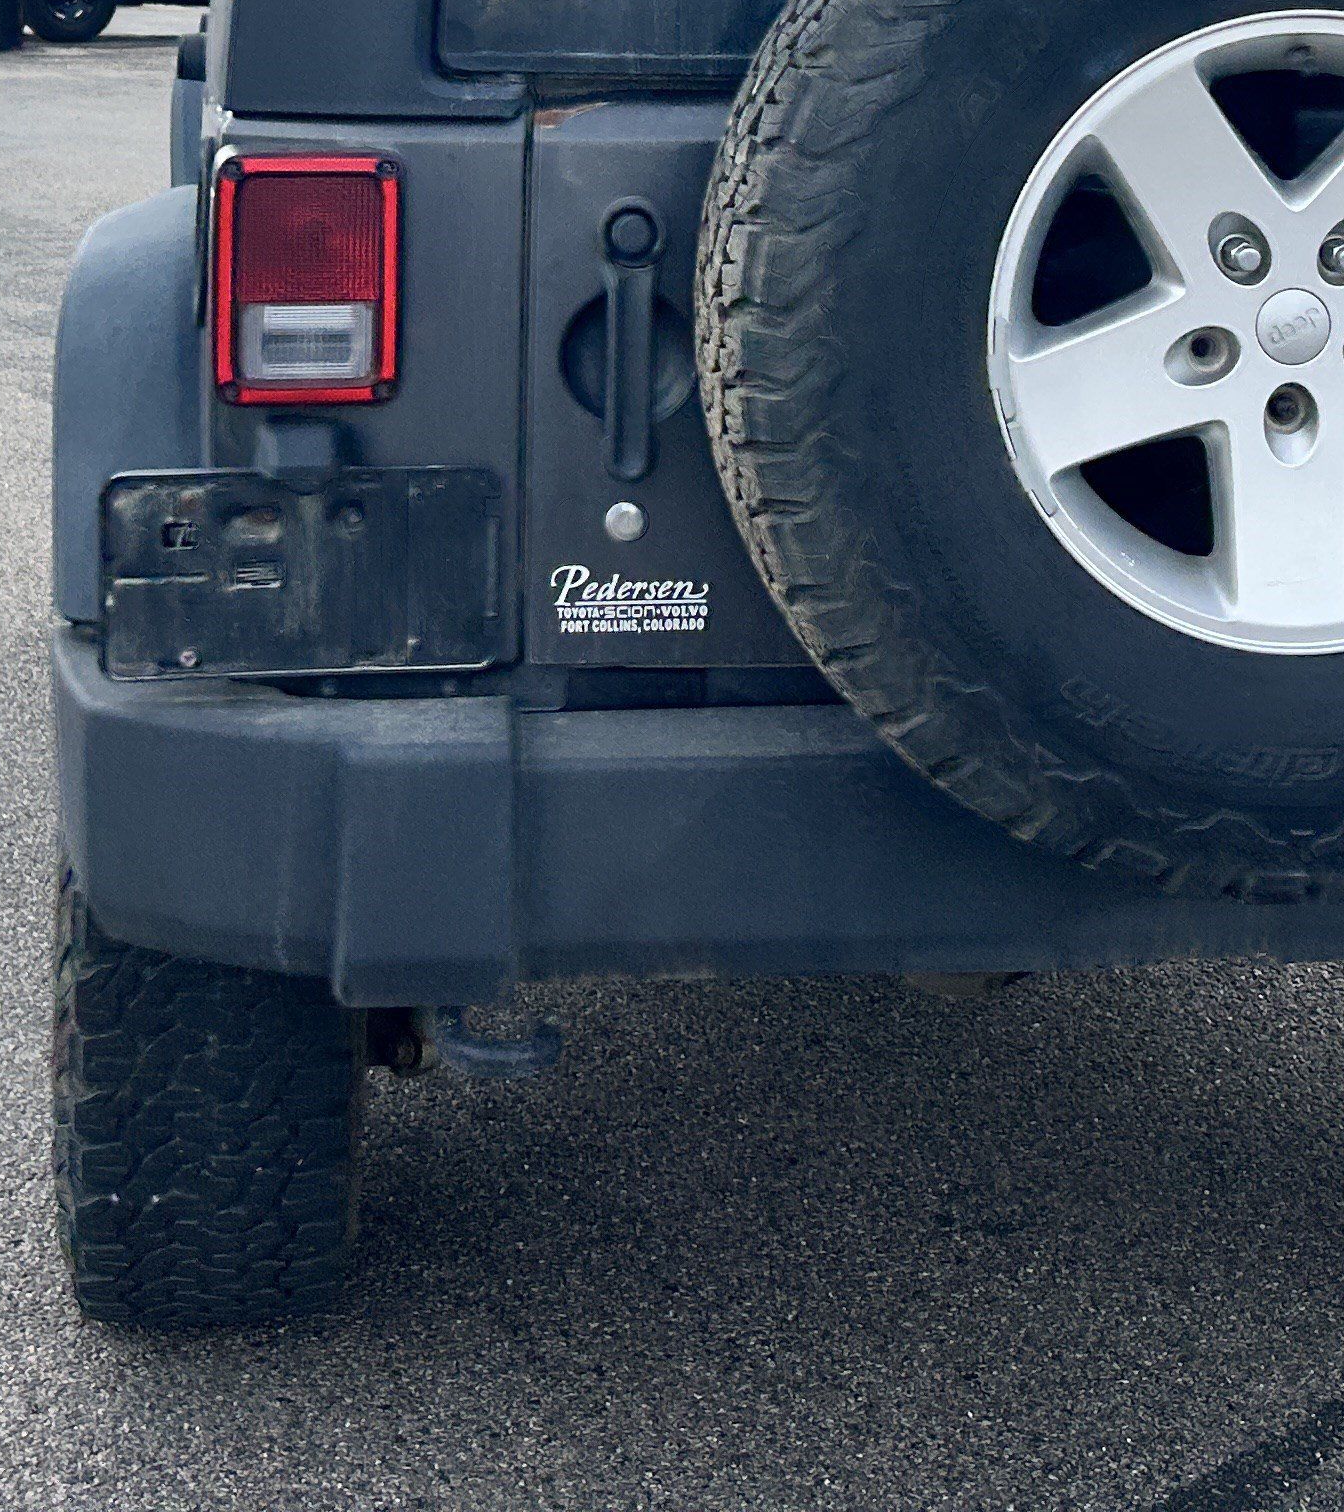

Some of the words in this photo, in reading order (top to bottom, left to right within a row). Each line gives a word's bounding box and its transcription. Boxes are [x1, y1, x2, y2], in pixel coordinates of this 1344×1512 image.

[1267, 307, 1320, 344] Jeep
[550, 564, 709, 606] Pedersen
[557, 607, 600, 619] TOYOTA
[660, 605, 709, 617] VOLVO
[560, 619, 590, 633] FORT
[591, 619, 643, 634] COLLINS,
[643, 617, 705, 631] COLORADO
